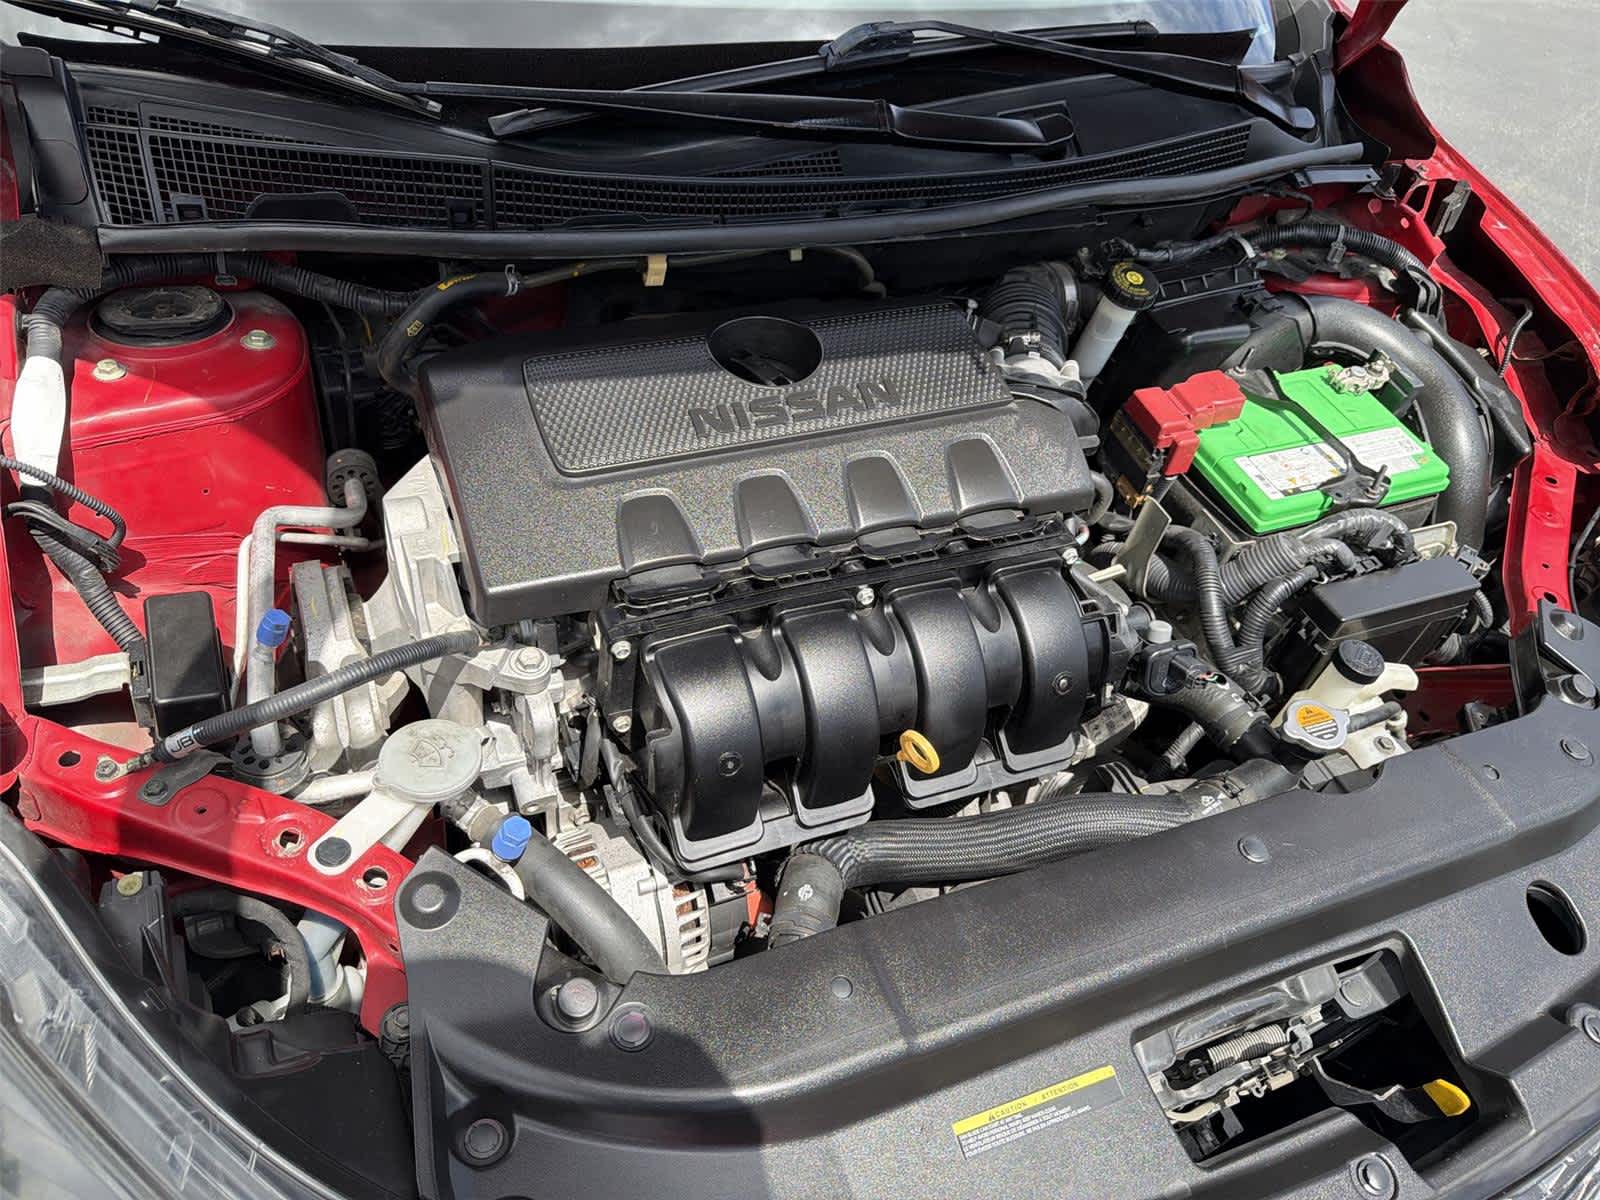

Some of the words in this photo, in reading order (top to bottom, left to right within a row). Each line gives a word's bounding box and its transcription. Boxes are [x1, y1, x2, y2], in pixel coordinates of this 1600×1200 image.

[688, 375, 900, 439] NISSAN
[994, 1101, 1027, 1118] CAUTION
[1041, 1082, 1080, 1099] ATTENTION
